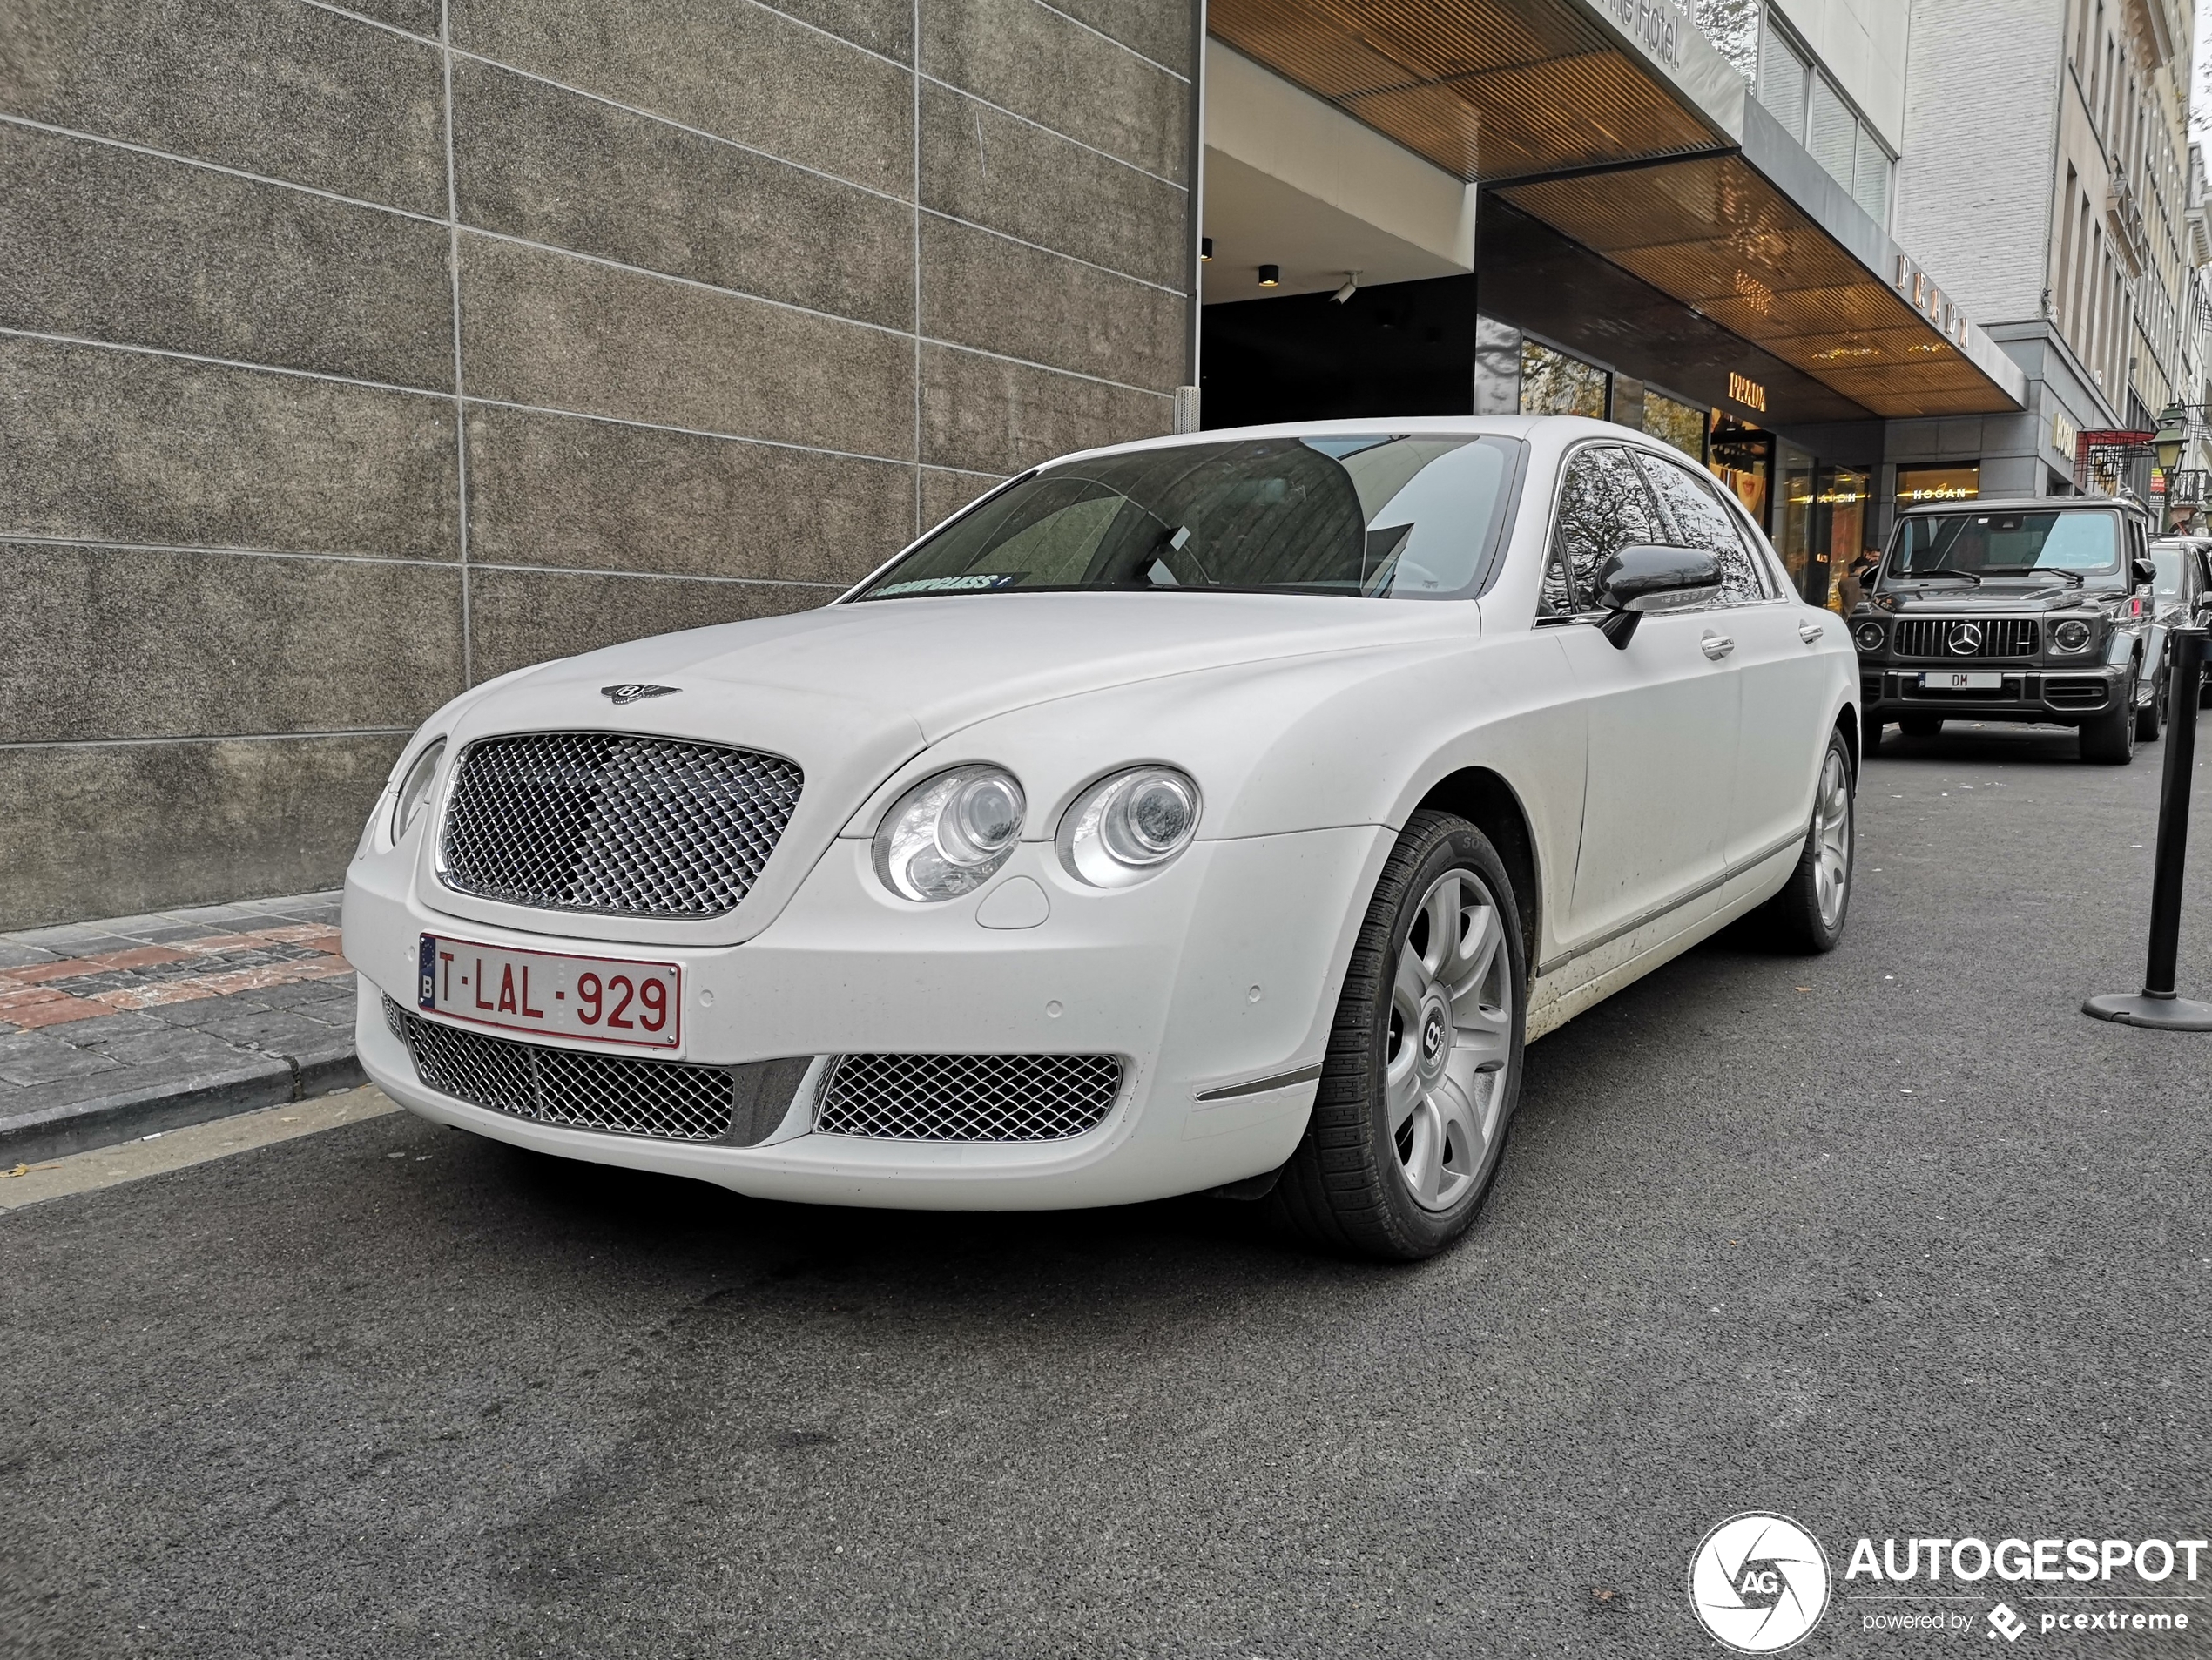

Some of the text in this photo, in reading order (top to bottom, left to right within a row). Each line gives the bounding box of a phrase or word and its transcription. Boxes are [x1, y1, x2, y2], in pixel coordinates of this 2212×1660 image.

[1895, 254, 1970, 348] PRADA
[1728, 371, 1767, 413] PRADA
[1913, 488, 1966, 500] HOGAN
[1952, 674, 1968, 686] DM
[422, 975, 433, 999] B
